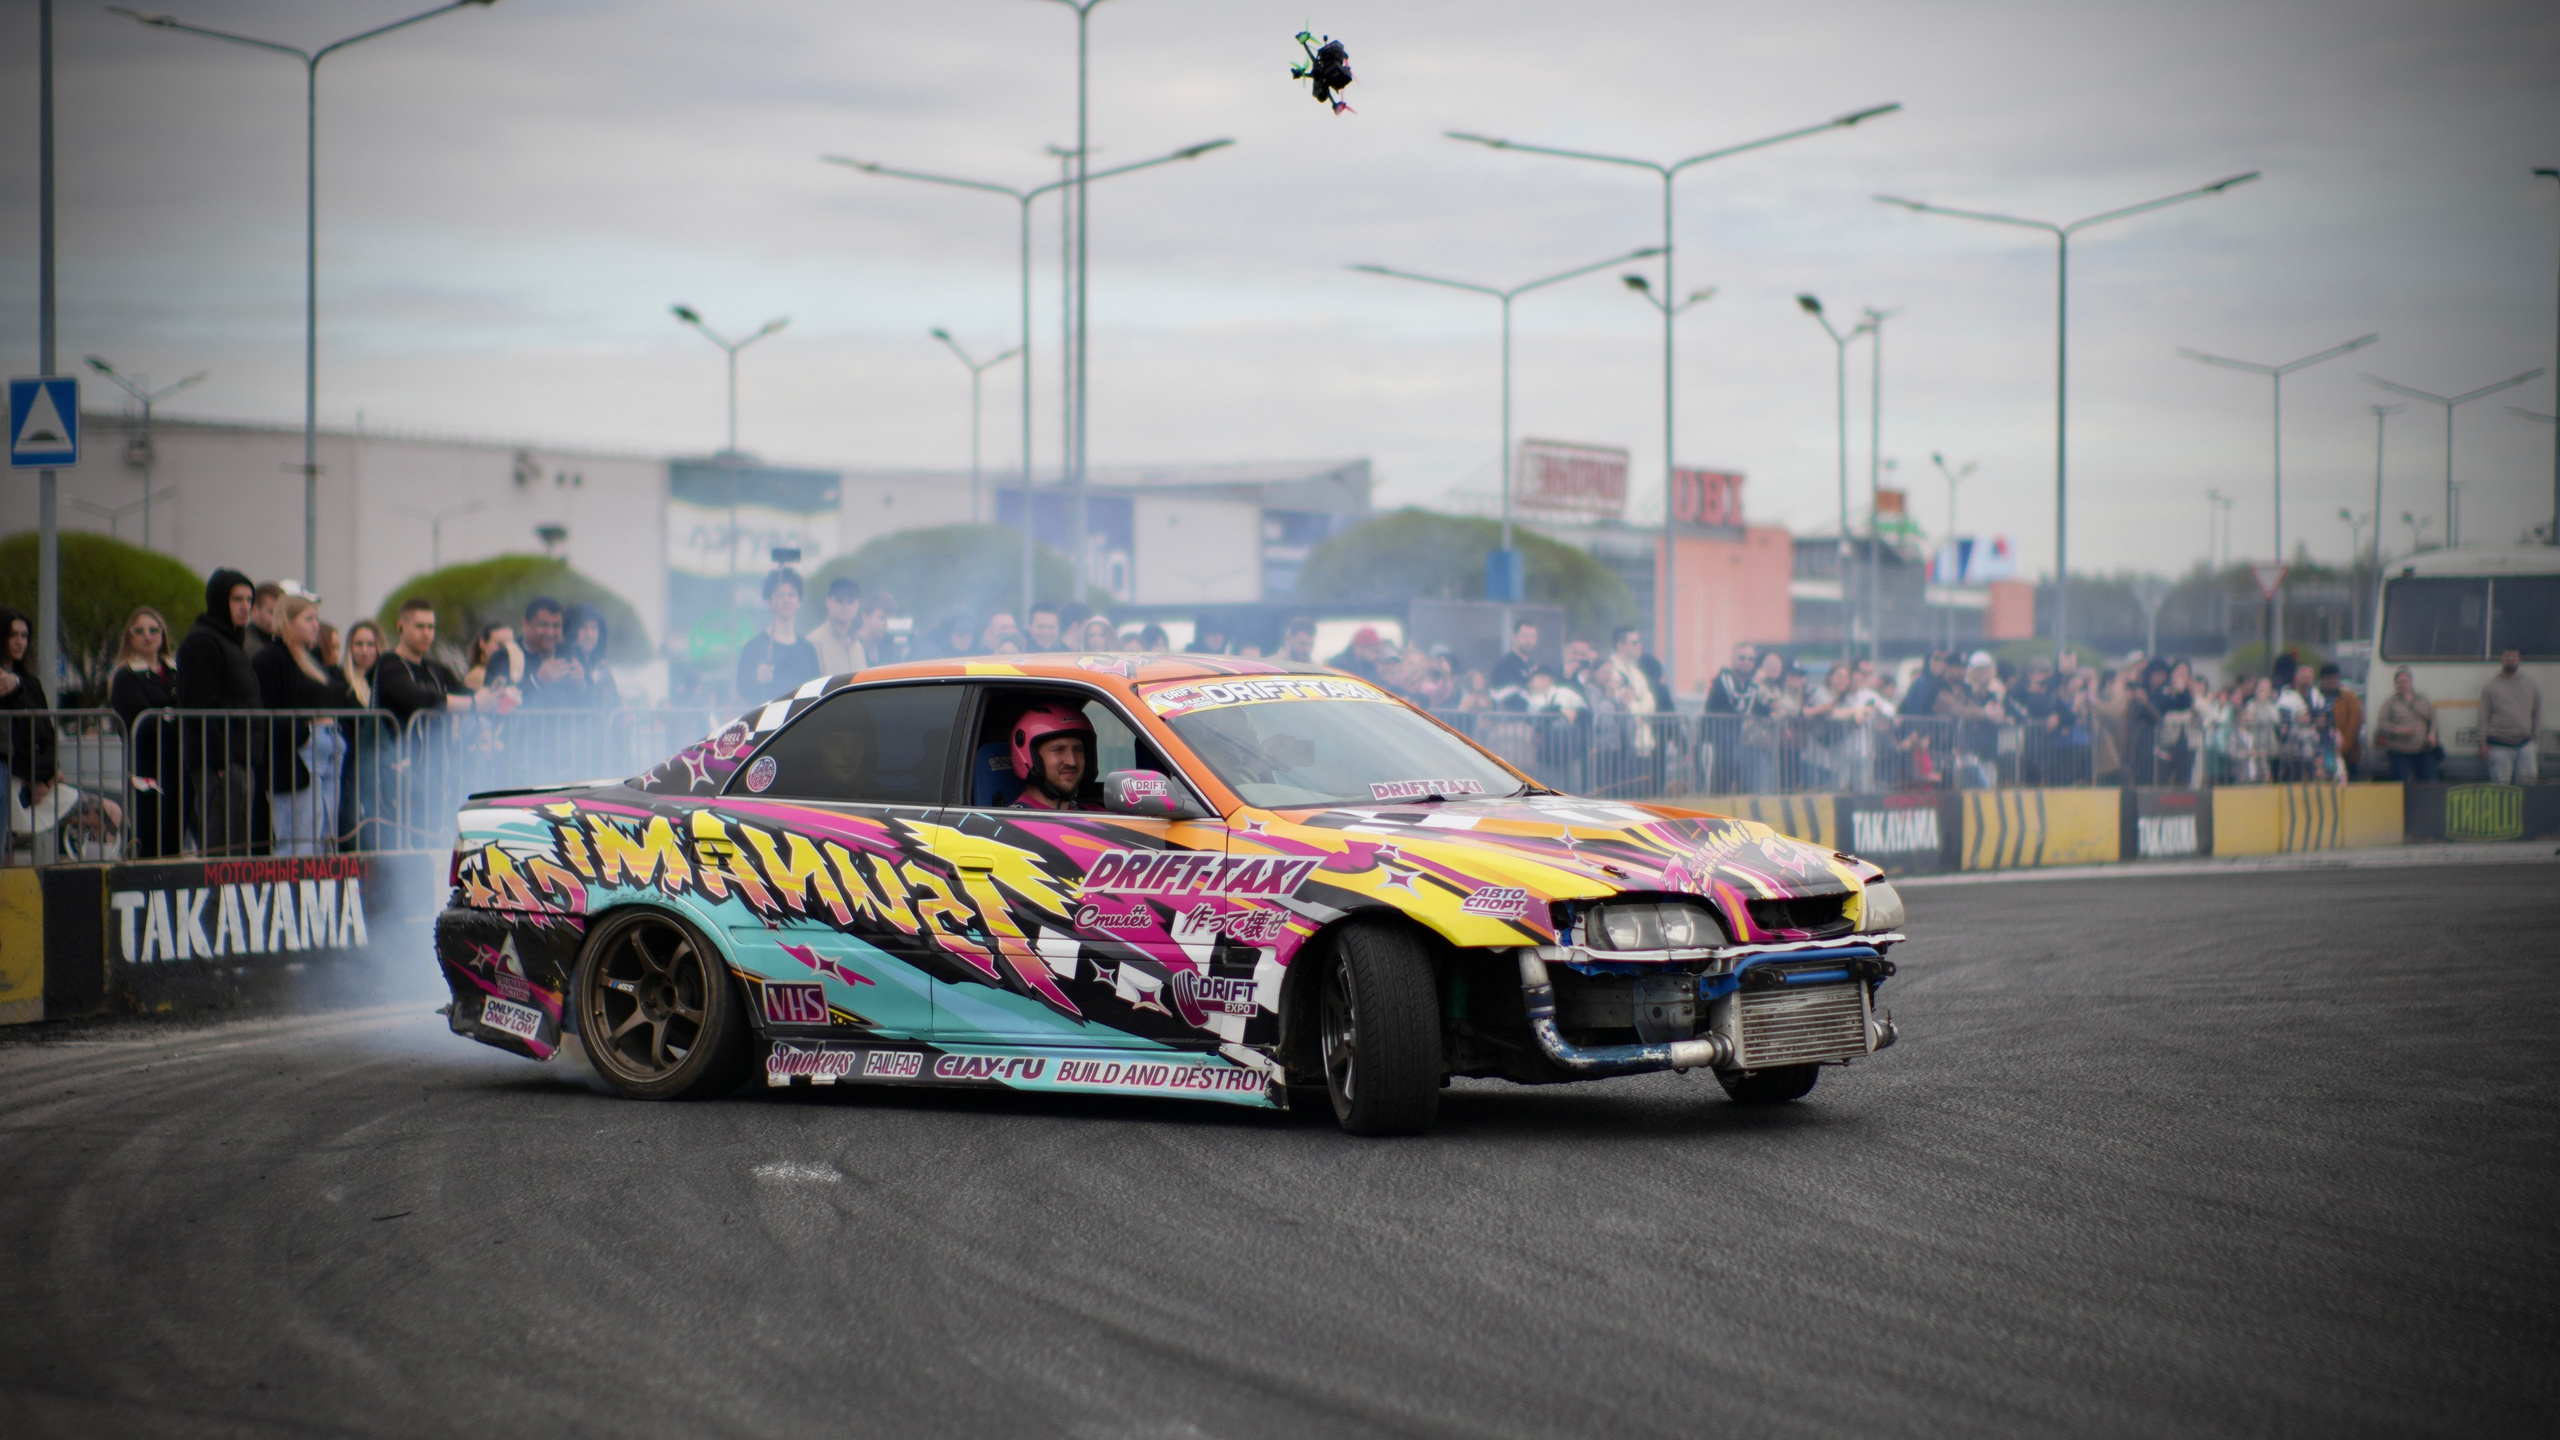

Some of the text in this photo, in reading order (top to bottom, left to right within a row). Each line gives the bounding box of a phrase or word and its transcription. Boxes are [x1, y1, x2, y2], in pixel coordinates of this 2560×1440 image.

[1673, 468, 1745, 526] OBI
[1165, 686, 1196, 701] DRIFT
[1200, 680, 1379, 706] DRIFT TAXI
[722, 733, 741, 742] HELL
[1135, 781, 1165, 790] DRIFT
[1371, 780, 1484, 799] DRIFT TAXI
[1852, 808, 1939, 851] TAKAYAMA
[204, 859, 299, 886] МОТОРНЫЕ
[303, 857, 361, 880] МАСЛА
[1081, 852, 1319, 895] DRIFT TAXI
[1463, 898, 1525, 911] СПОРТ
[1473, 888, 1526, 899] АВТО
[111, 877, 369, 963] TAKAYAMA
[1181, 904, 1289, 939] 作って壊せ
[498, 986, 530, 1002] FACTORY
[1200, 979, 1258, 1002] DRIFT
[487, 1000, 539, 1023] ONLY FAST
[768, 986, 823, 1022] VHS
[1224, 1003, 1251, 1014] EXPO
[484, 1010, 536, 1035] ONLY LOW
[768, 1041, 854, 1075] Smokers
[1056, 1061, 1272, 1091] BUILD AND DESTROY
